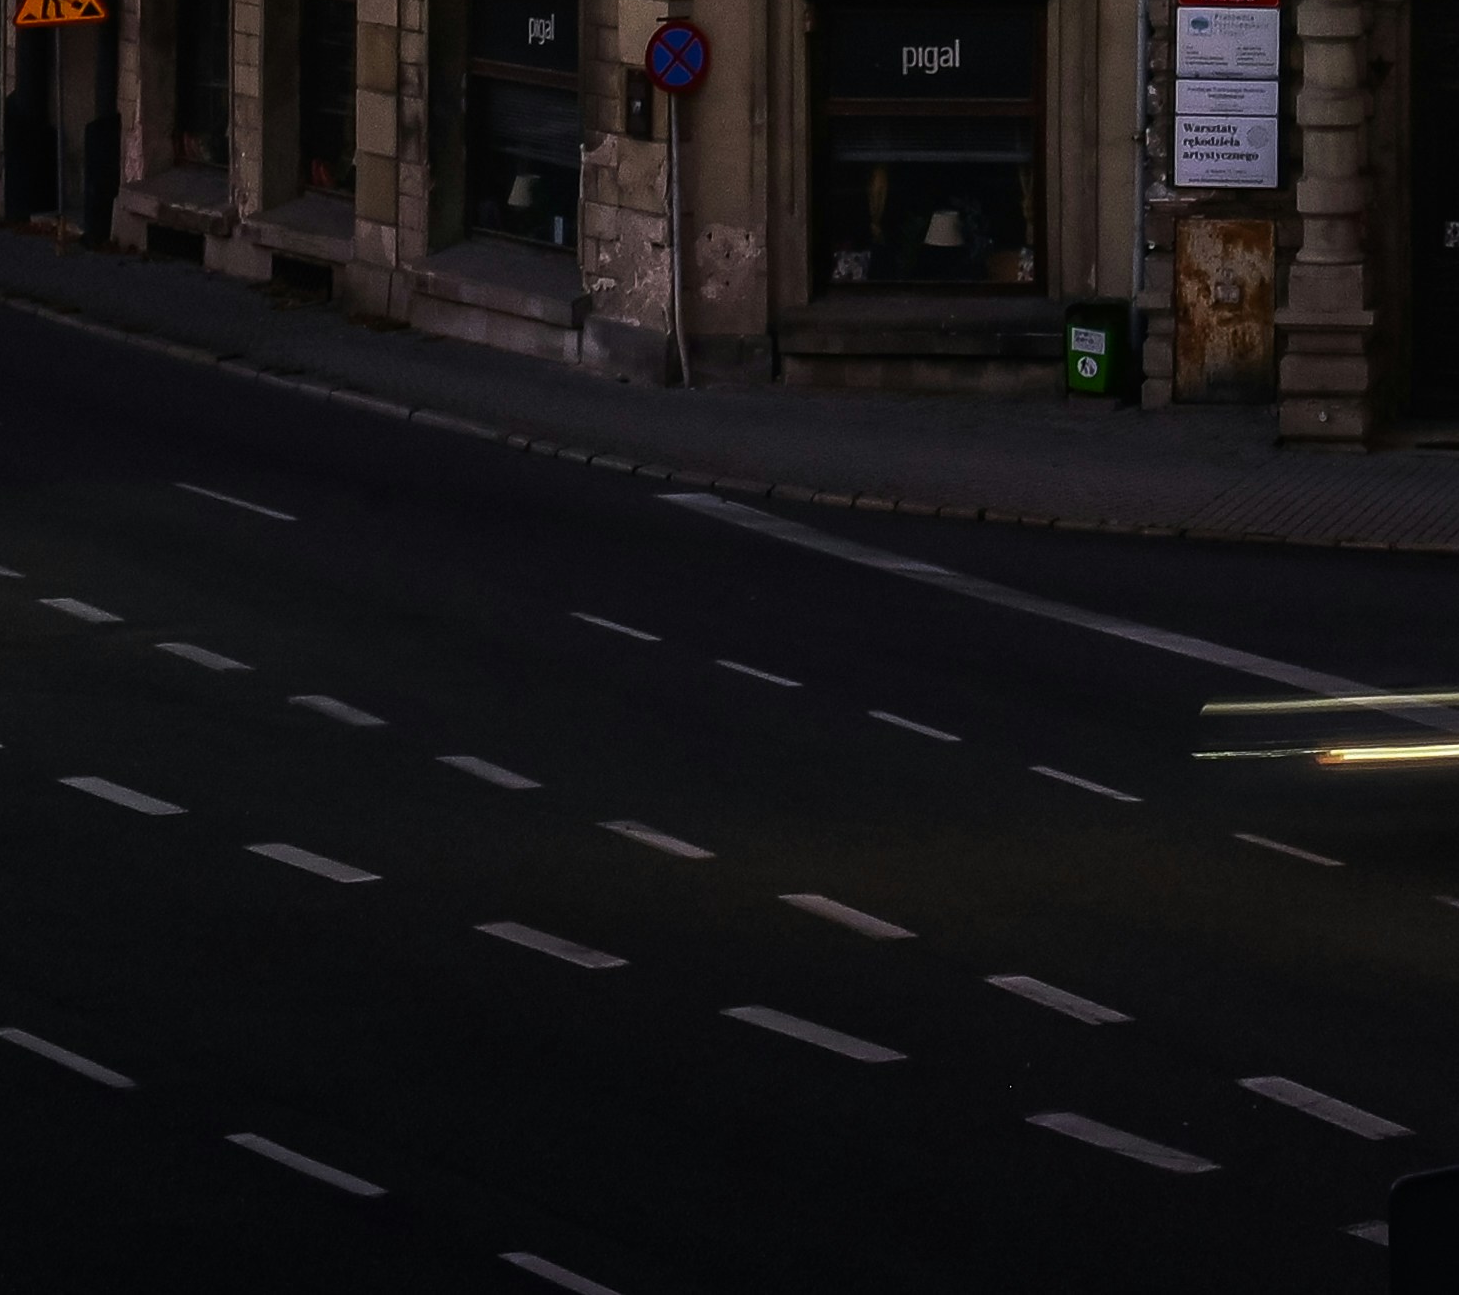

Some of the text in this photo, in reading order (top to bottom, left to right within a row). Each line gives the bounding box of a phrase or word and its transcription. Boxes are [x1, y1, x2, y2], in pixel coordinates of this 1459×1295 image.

[528, 13, 555, 46] pigal
[902, 38, 960, 76] pigal
[1183, 123, 1238, 135] Warsztaty
[1183, 137, 1240, 148] rękodzieła
[1182, 151, 1259, 162] artystycznego
